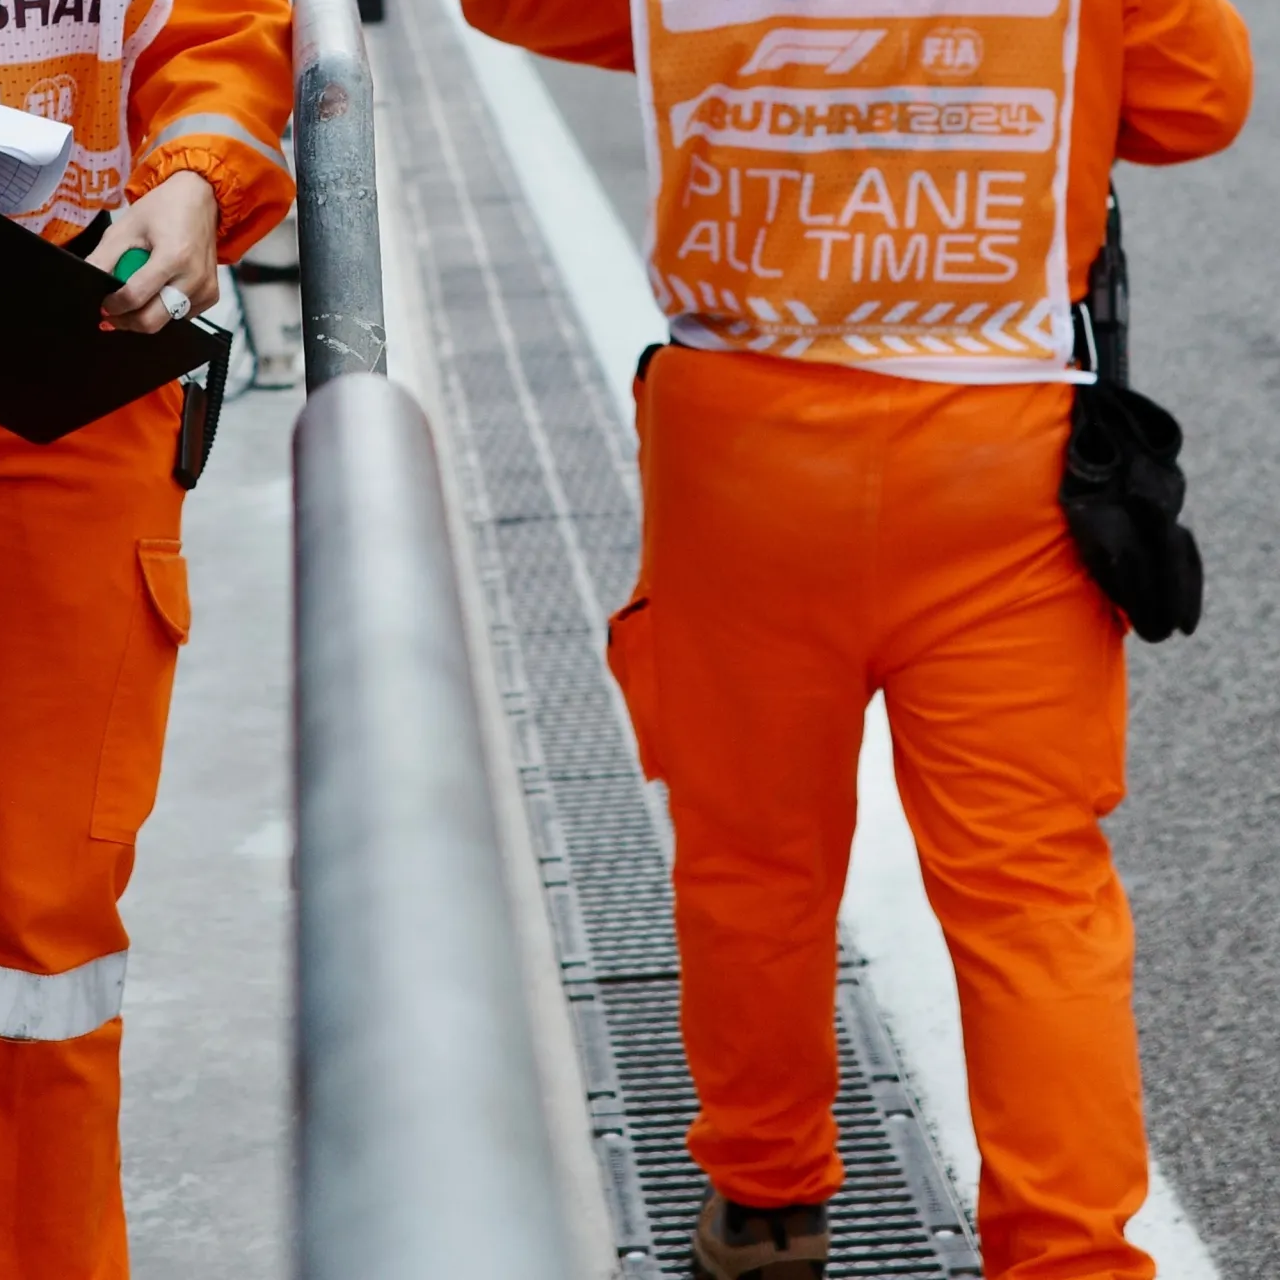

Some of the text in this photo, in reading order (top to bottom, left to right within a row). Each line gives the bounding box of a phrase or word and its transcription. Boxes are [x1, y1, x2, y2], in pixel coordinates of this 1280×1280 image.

[922, 36, 980, 71] FIA
[682, 154, 1027, 231] PITLANE
[678, 220, 1019, 283] ALL TIMES
